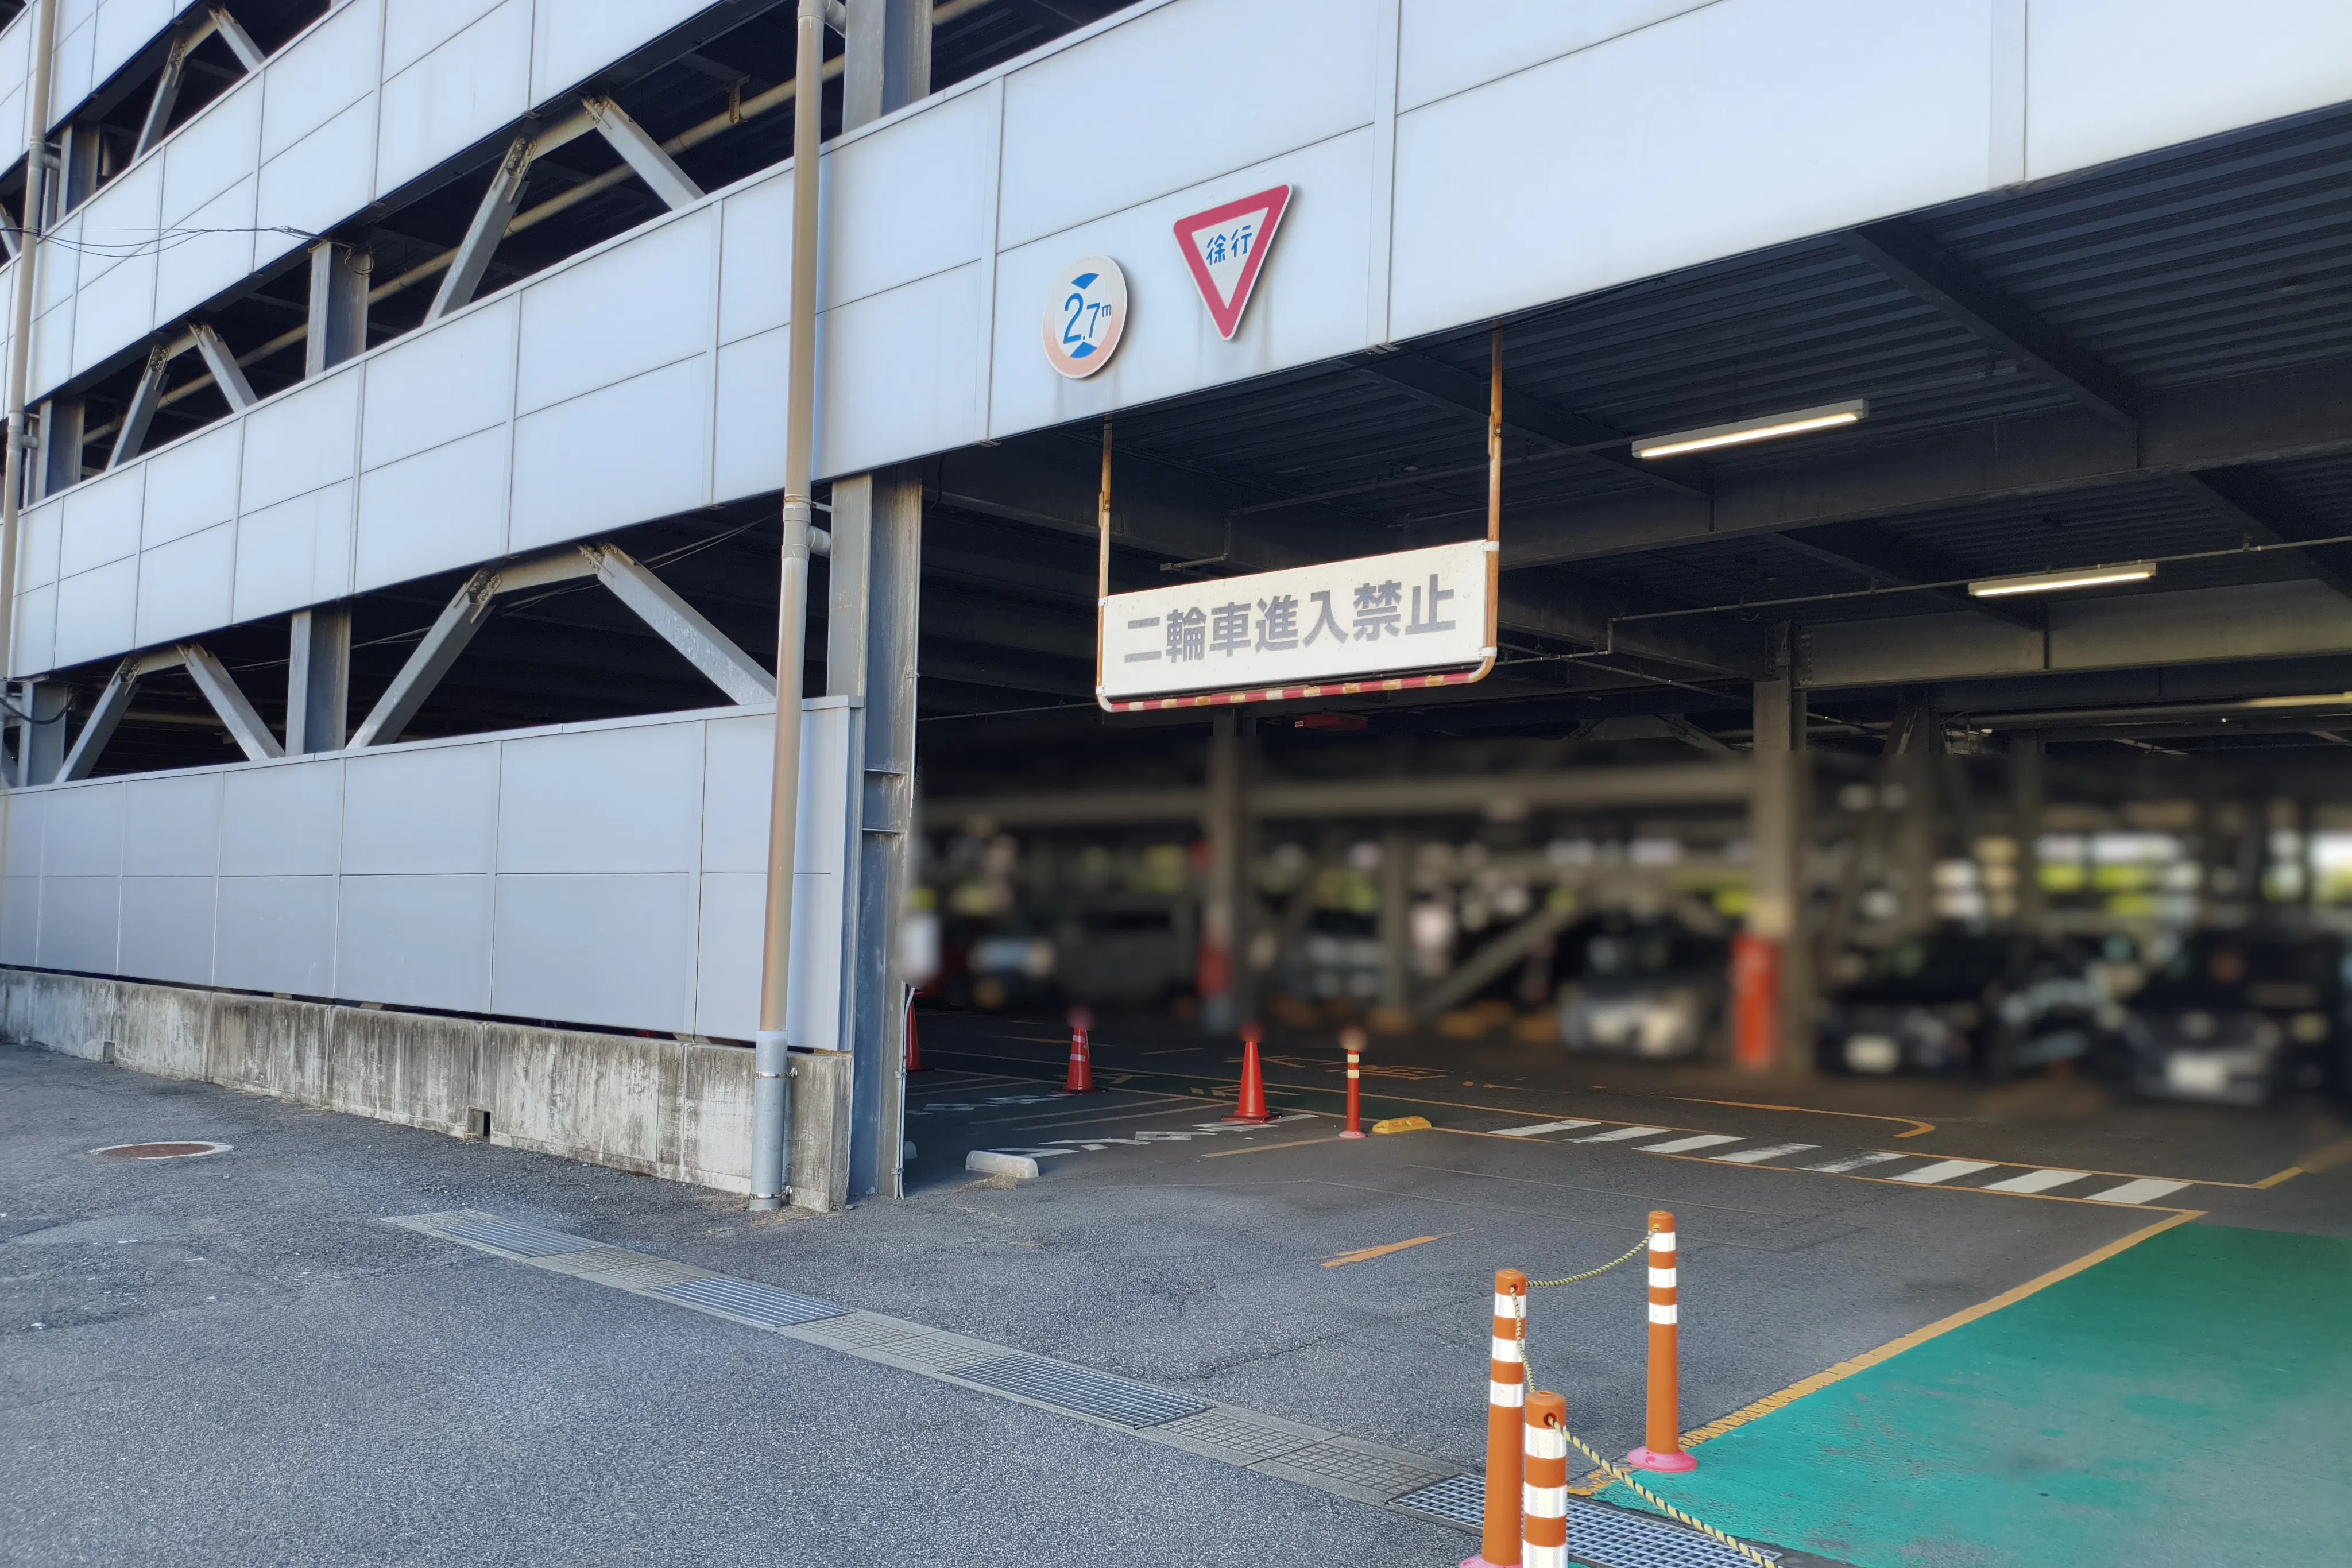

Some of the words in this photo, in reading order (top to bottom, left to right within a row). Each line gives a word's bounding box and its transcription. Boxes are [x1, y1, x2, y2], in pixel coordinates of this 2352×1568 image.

[1206, 224, 1252, 266] 徐行
[1063, 292, 1112, 344] 2.7m
[1124, 574, 1456, 664] 二輪車進入禁止
